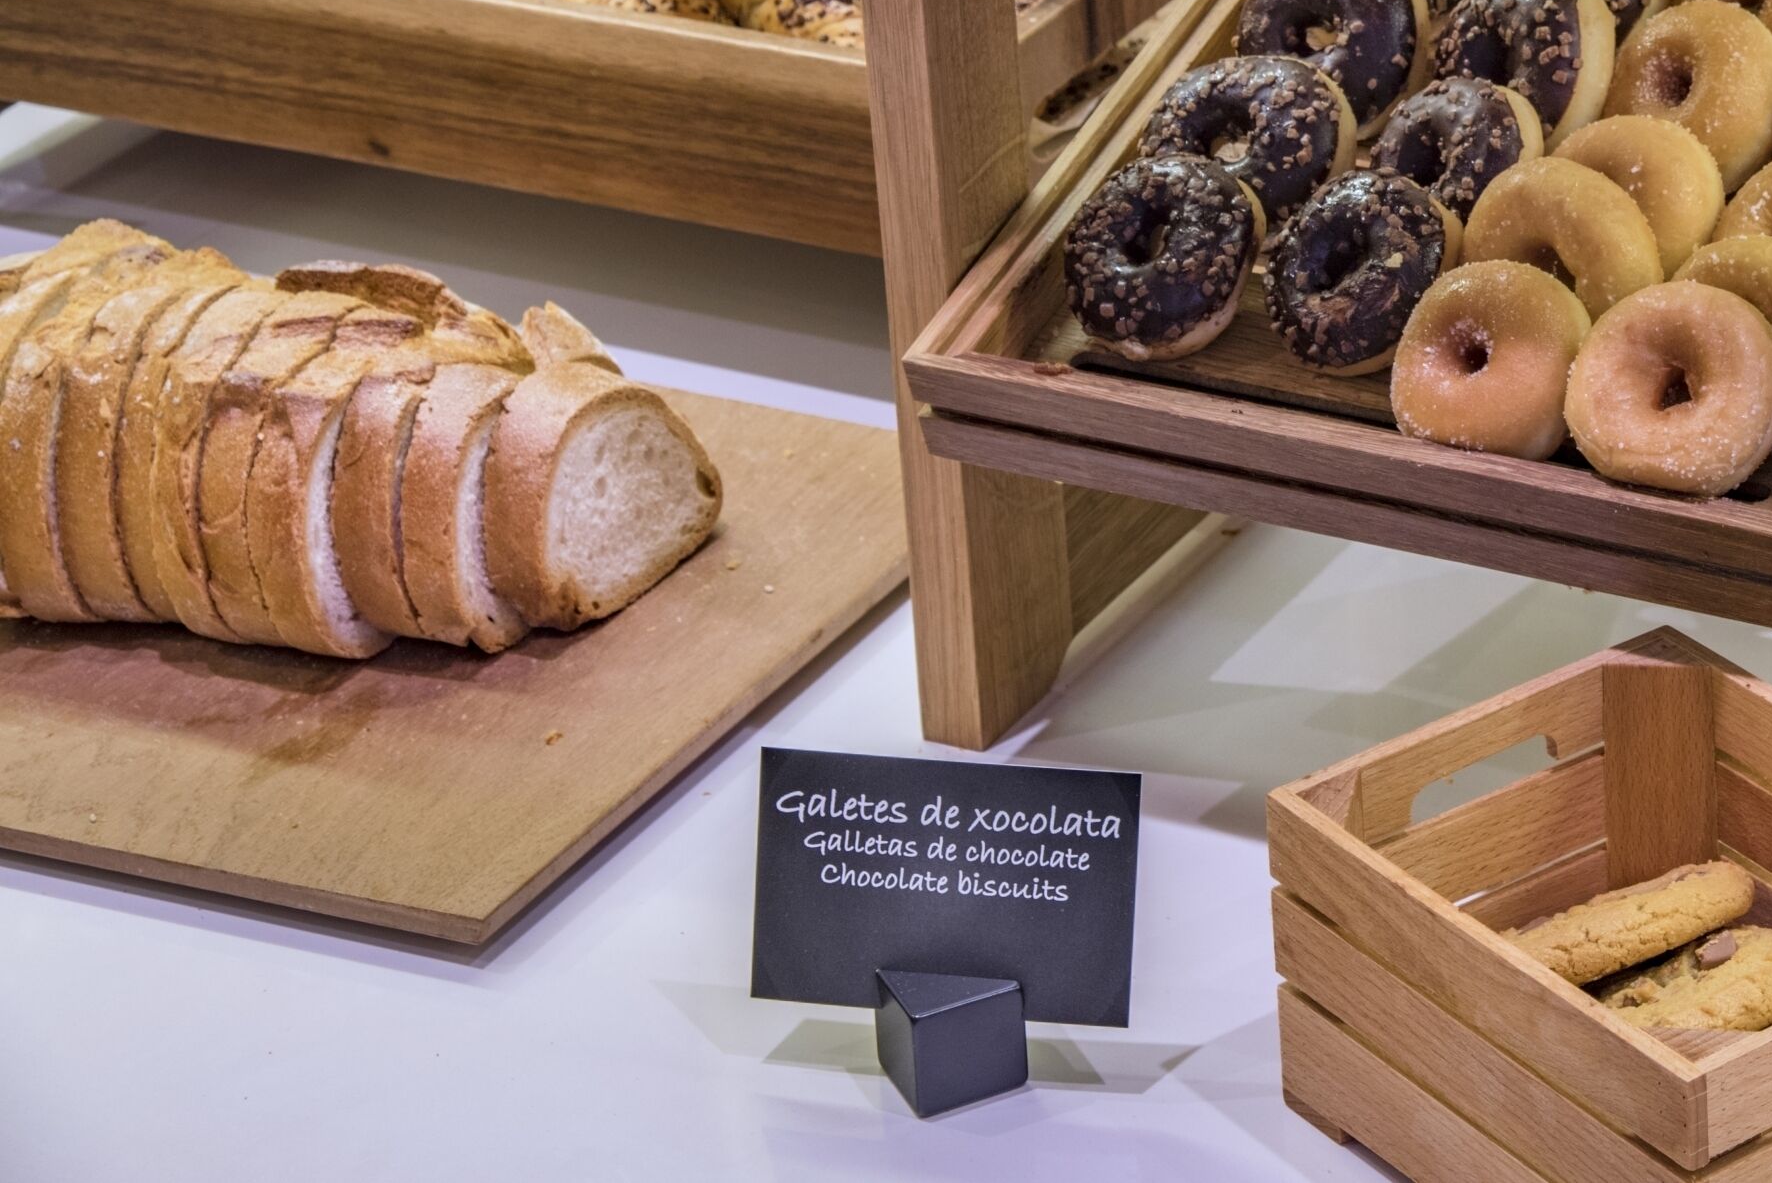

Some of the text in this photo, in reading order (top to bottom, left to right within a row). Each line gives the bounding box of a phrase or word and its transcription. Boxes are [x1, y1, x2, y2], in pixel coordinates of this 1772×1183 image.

[775, 788, 1121, 839] Galetes de xocolata
[803, 829, 1090, 871] Galletas de chocolate
[820, 862, 1069, 902] Chocolate biscuits
